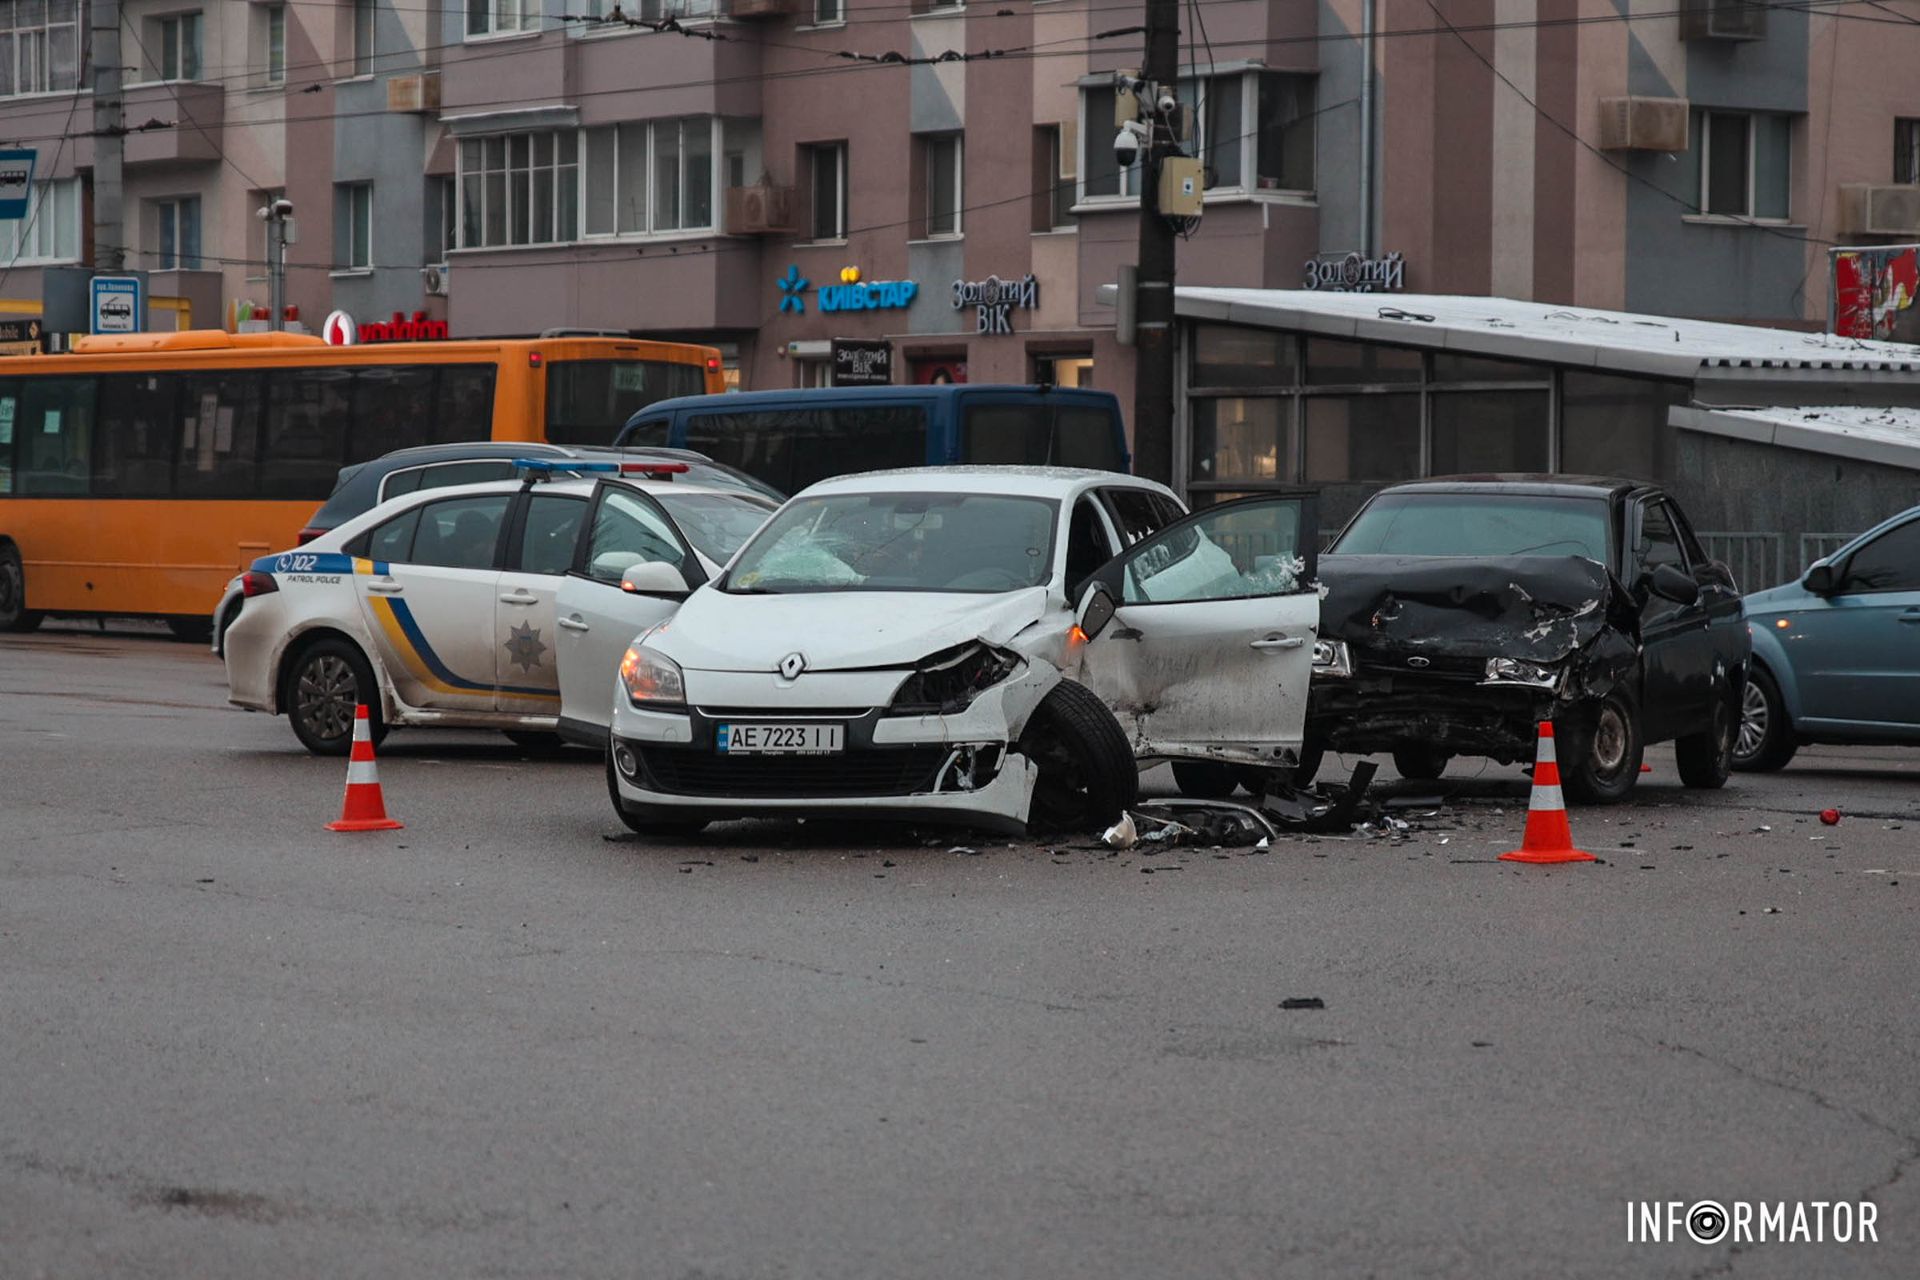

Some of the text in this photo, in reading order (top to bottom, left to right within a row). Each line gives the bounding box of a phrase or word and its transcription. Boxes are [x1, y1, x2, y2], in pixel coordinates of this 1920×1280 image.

[357, 310, 448, 342] vodafon
[291, 555, 317, 571] 102
[287, 575, 341, 584] PATROL POLICE
[762, 727, 806, 748] 7223
